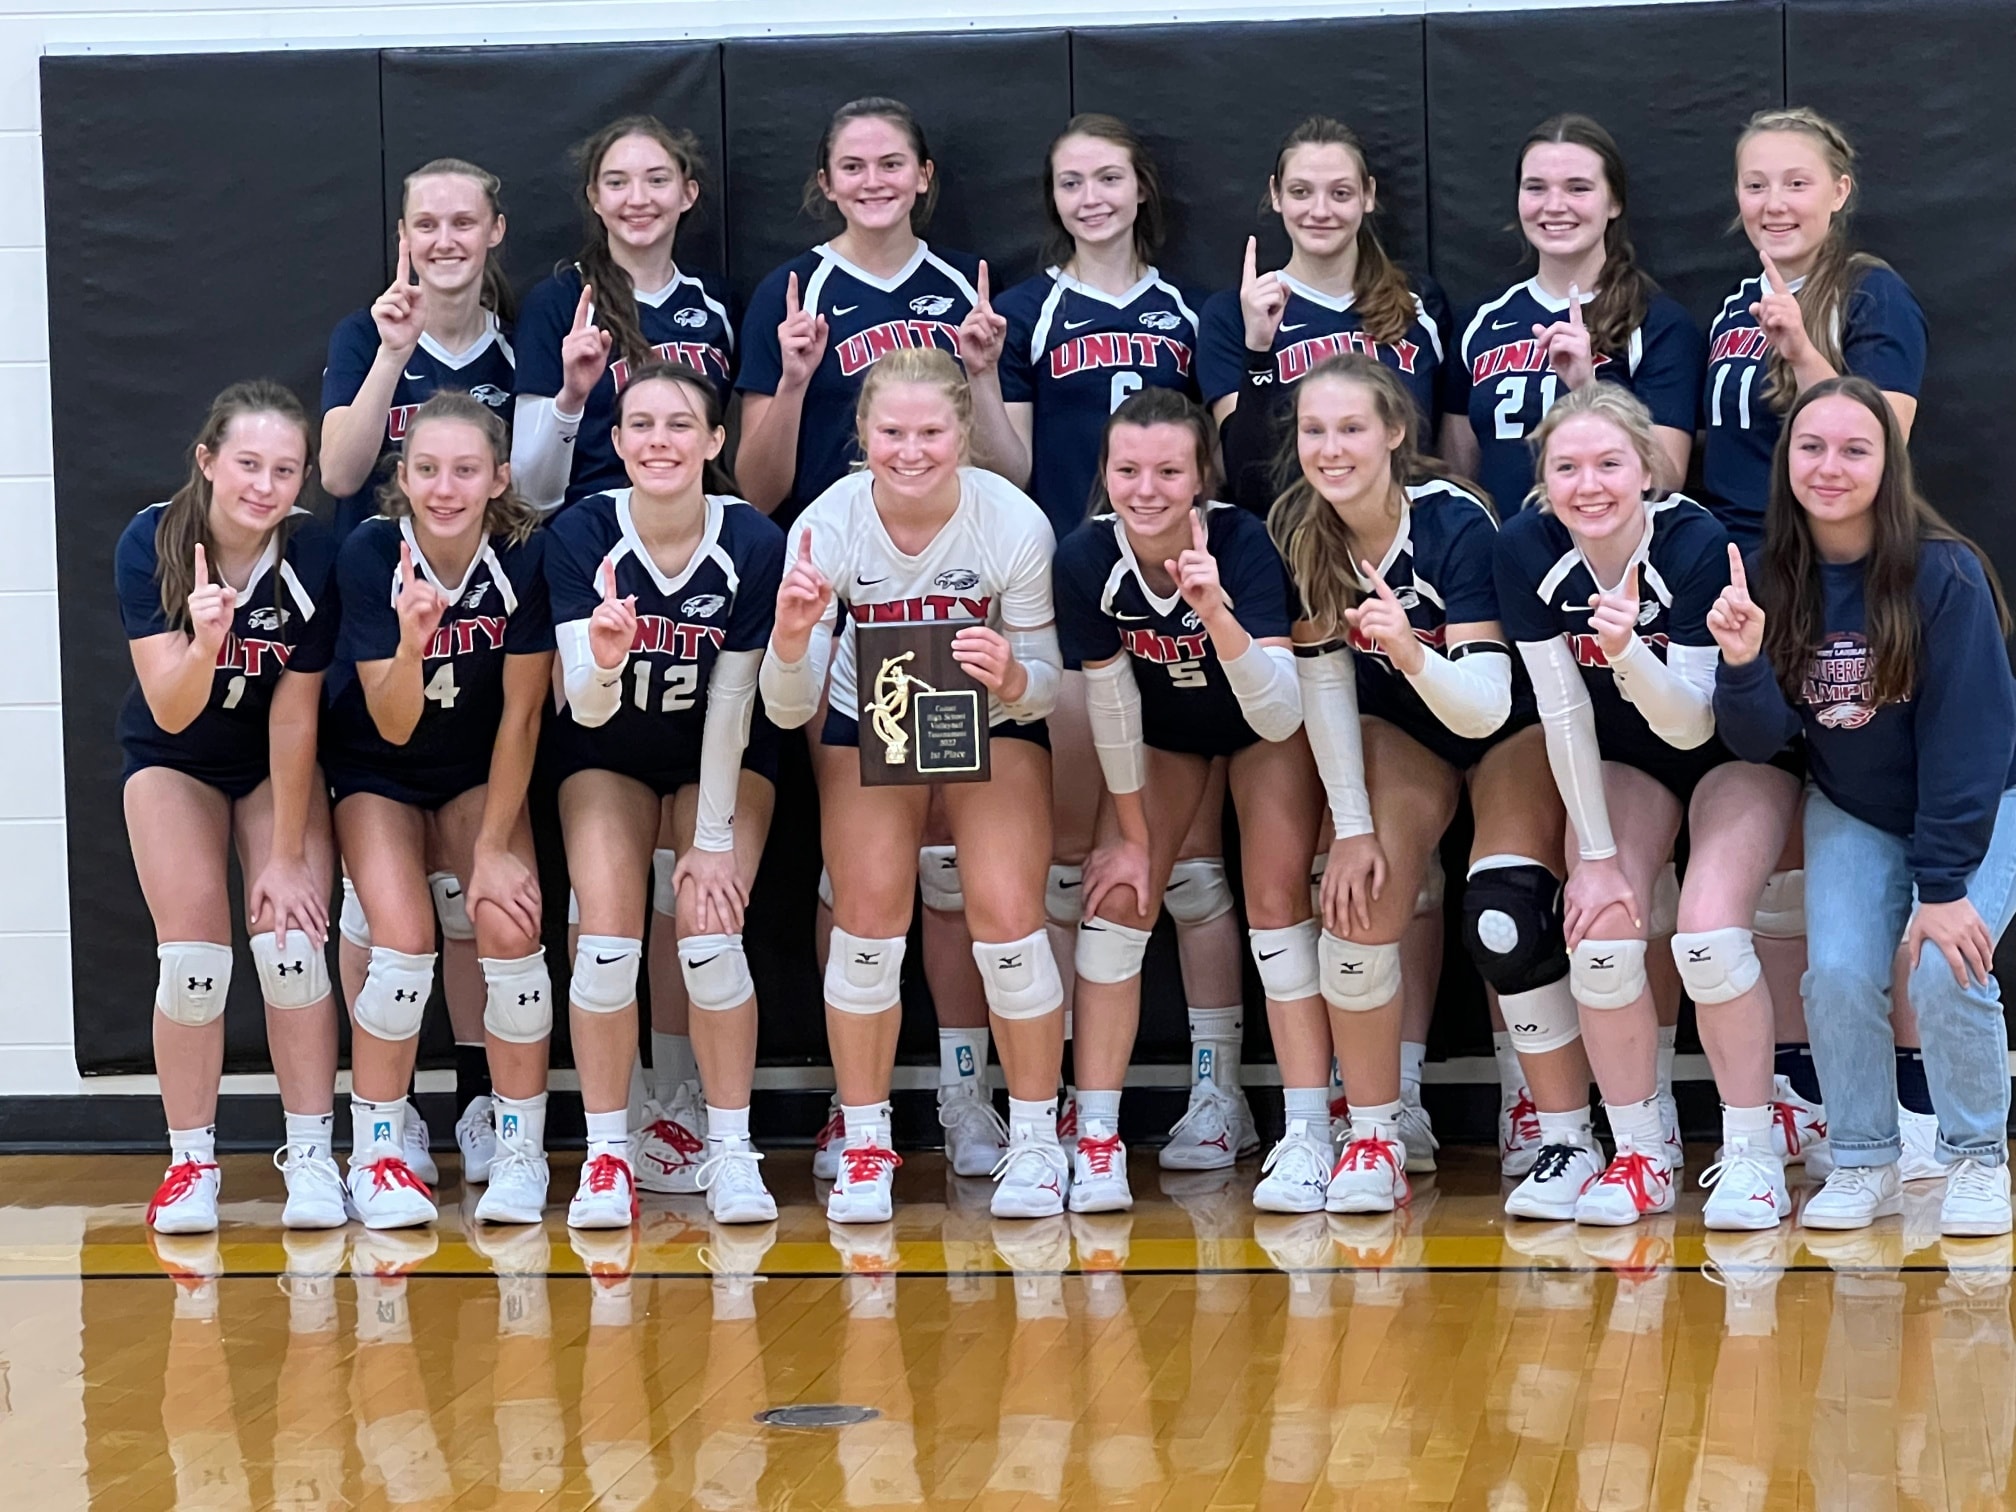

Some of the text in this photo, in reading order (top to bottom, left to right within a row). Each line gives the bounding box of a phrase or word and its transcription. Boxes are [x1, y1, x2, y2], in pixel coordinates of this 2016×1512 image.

[1050, 332, 1192, 379] UNITY
[1275, 331, 1420, 376] UNITY
[1494, 374, 1558, 439] 21
[1712, 363, 1757, 429] 11
[222, 675, 246, 709] 1
[424, 662, 461, 709] 4
[633, 659, 698, 713] 12
[1166, 660, 1208, 688] 5
[930, 750, 966, 760] 1st Place
